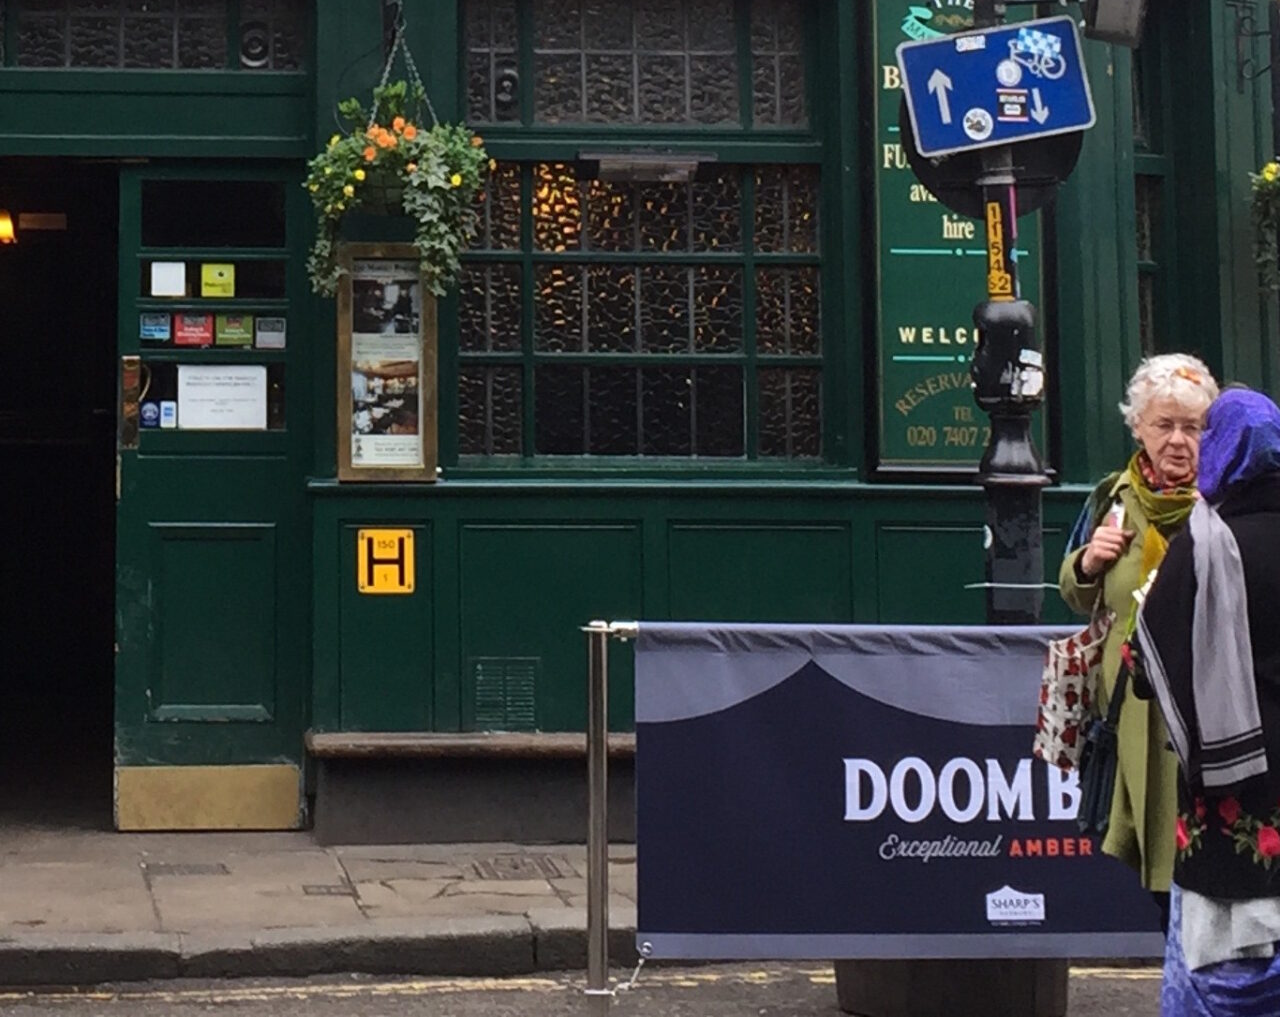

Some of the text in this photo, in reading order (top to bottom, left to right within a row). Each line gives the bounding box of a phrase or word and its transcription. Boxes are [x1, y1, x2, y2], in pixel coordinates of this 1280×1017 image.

[942, 214, 976, 239] hire
[898, 326, 980, 345] WELC
[895, 372, 973, 417] RESERVA
[907, 426, 937, 447] 020
[943, 426, 978, 447] 7407
[842, 756, 1036, 824] DOOM
[879, 834, 1094, 863] Exceptional AMBER
